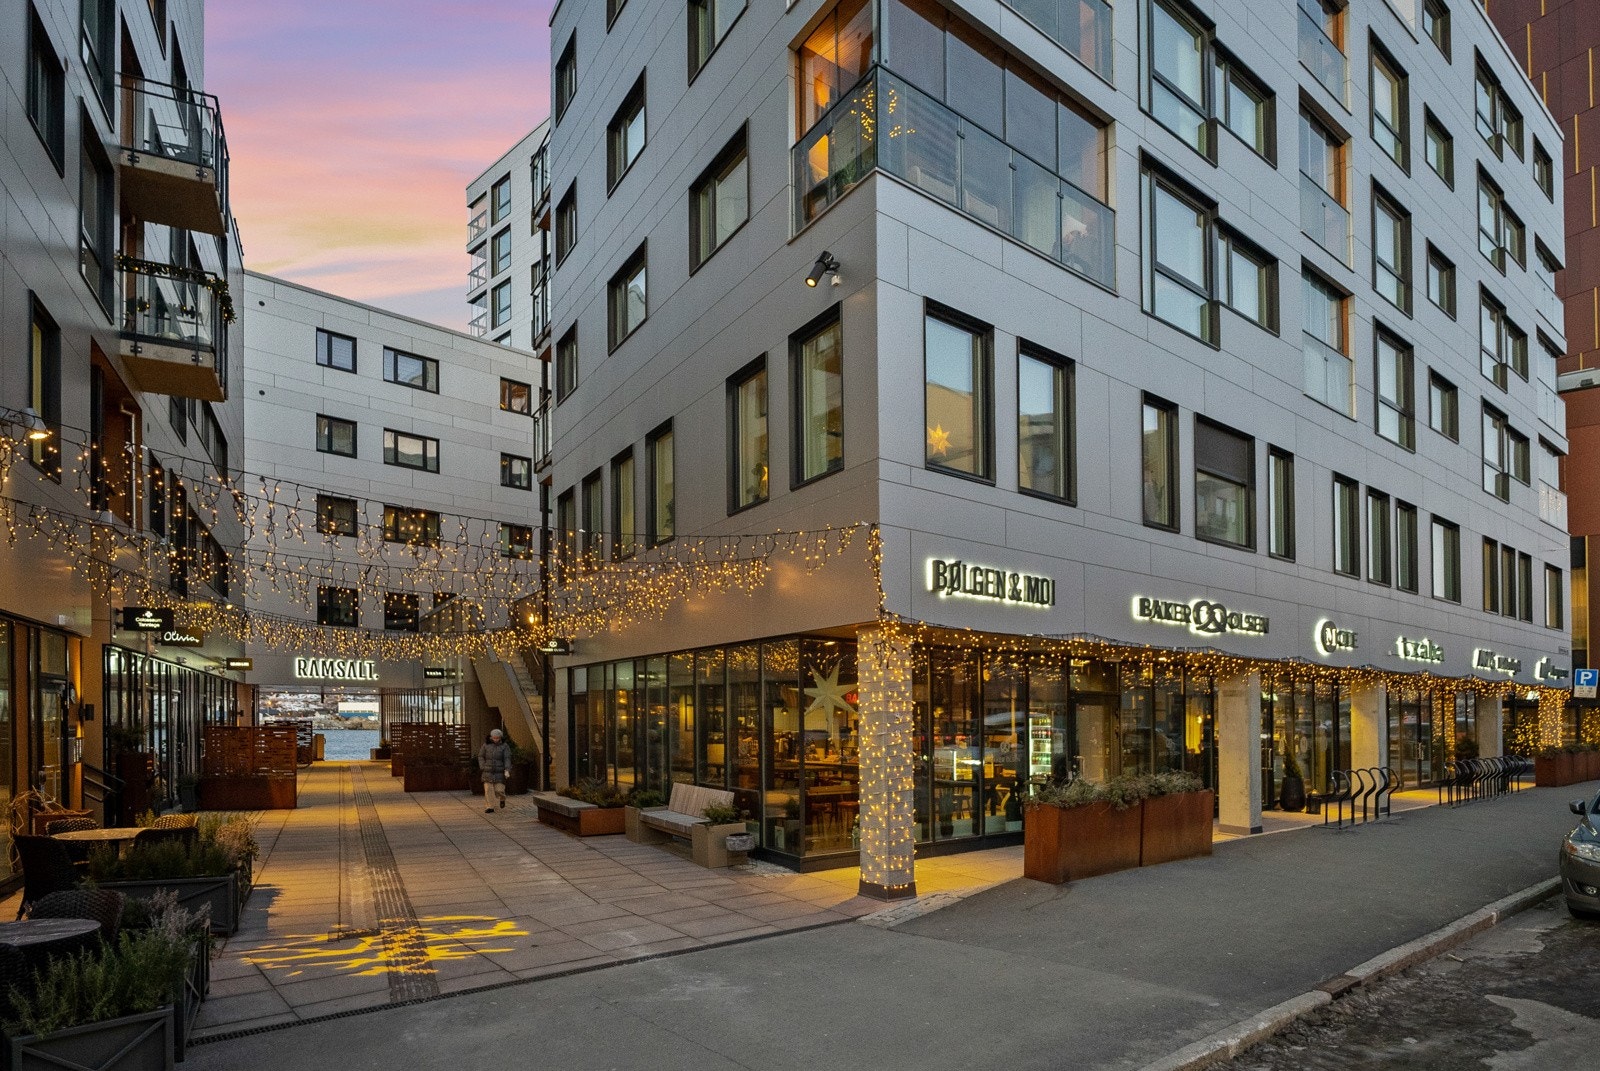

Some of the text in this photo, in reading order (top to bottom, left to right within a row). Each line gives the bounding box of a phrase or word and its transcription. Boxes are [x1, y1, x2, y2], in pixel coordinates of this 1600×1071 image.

[930, 559, 1056, 605] BØLGEN & MOI
[1138, 597, 1270, 634] BAKER OLSEN
[1580, 671, 1593, 685] P
